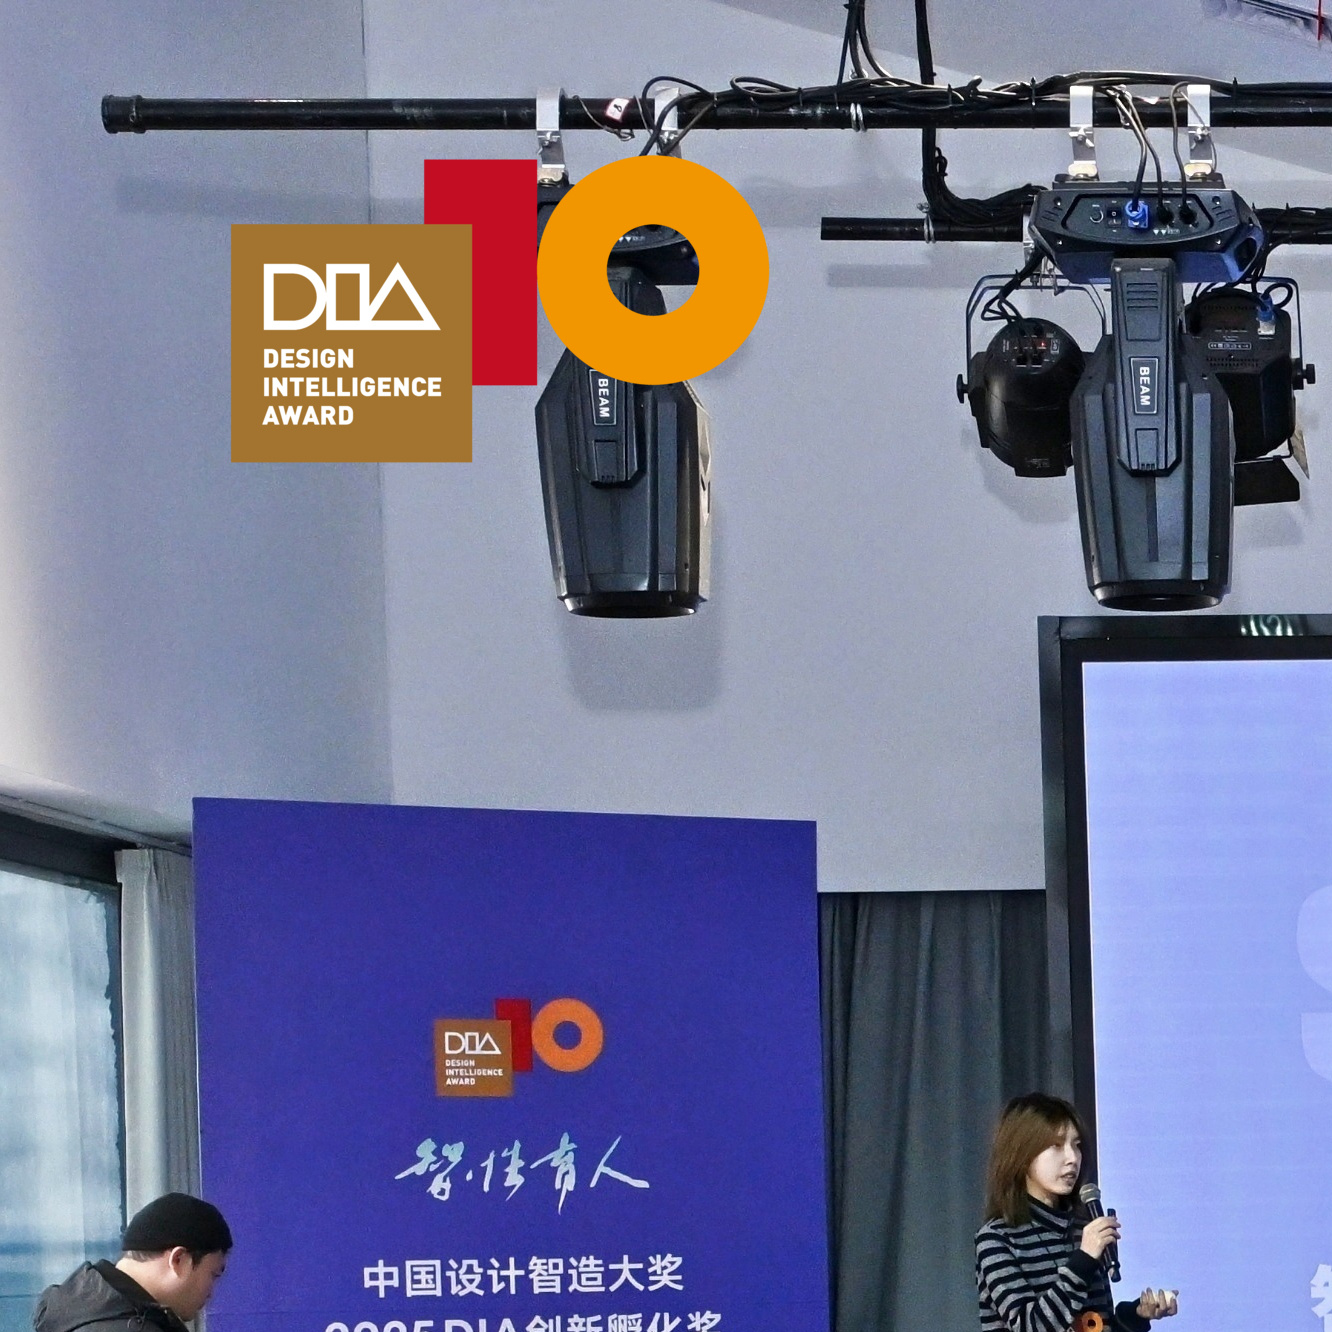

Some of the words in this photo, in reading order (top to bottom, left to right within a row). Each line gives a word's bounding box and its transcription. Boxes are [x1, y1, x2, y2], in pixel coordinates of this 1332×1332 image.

[597, 378, 610, 419] BEAM
[1138, 366, 1150, 407] BEAM
[445, 1059, 475, 1067] DESIGN
[445, 1068, 504, 1076] INTELLIGENCE
[362, 1253, 685, 1299] 中国设计智造大奖
